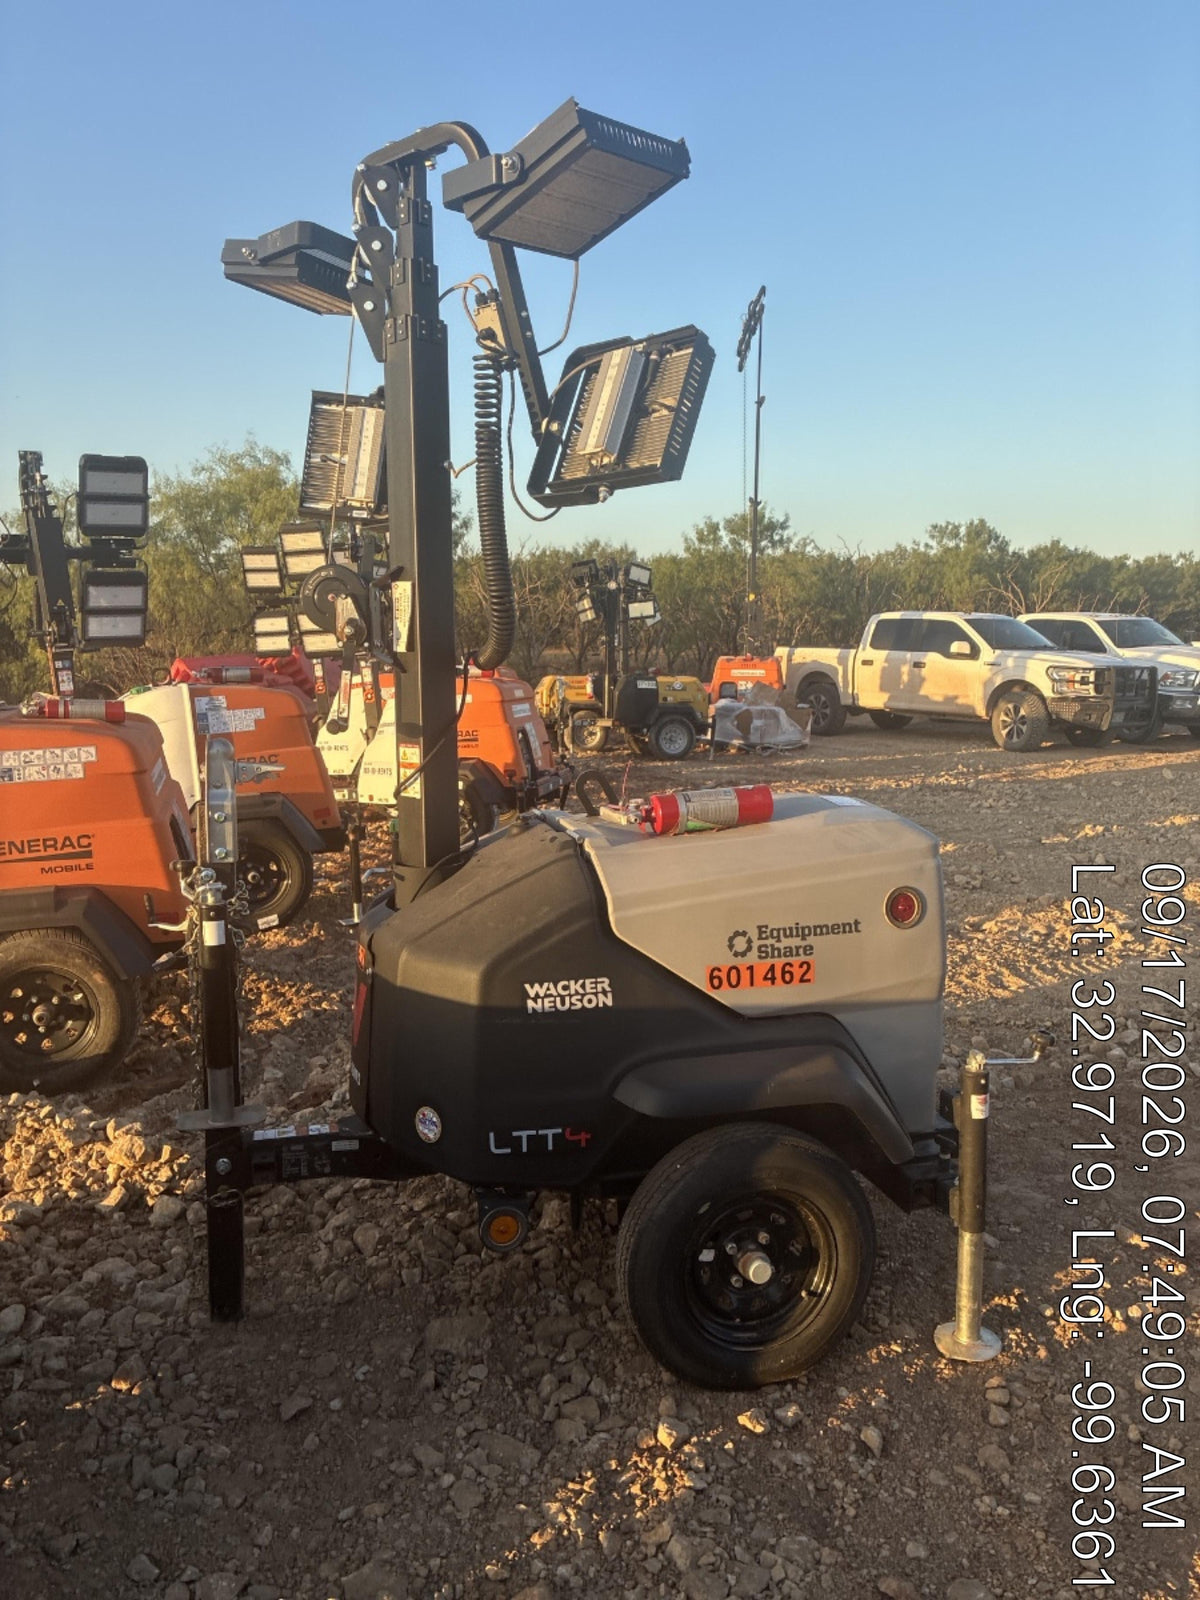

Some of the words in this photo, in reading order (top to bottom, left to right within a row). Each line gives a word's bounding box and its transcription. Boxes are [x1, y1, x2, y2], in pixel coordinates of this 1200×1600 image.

[40, 863, 94, 875] MOBILE
[756, 918, 862, 943] Equipment
[757, 943, 814, 960] Share
[708, 961, 812, 990] 601462
[524, 977, 612, 998] WACKER
[526, 992, 613, 1014] NEUSON
[489, 1127, 592, 1155] LTT4
